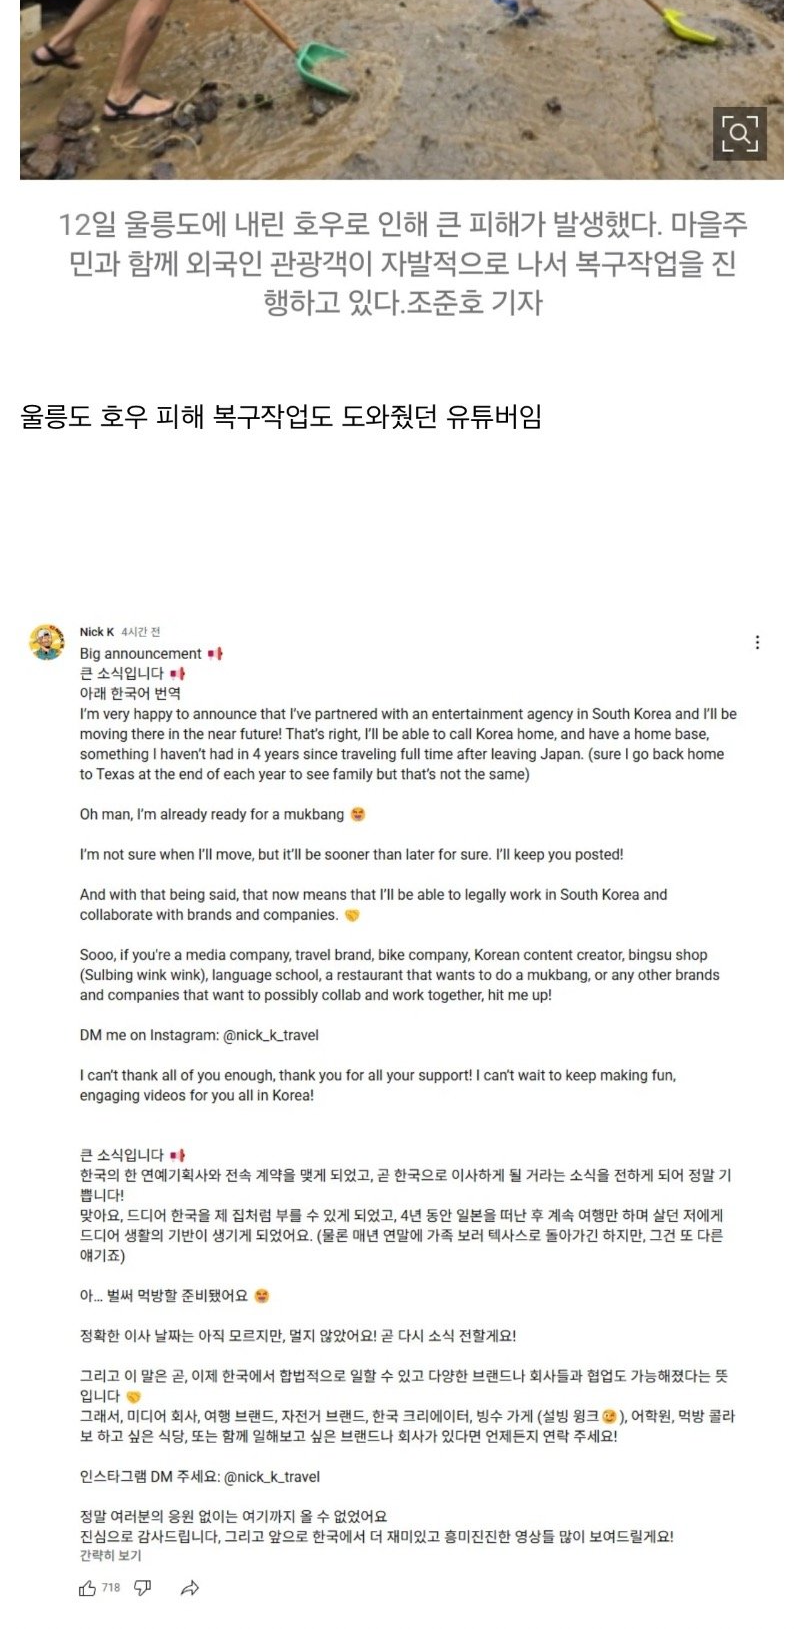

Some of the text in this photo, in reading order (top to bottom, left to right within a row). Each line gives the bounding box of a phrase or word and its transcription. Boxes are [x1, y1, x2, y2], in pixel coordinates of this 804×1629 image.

[80, 627, 160, 637] Nick K 4시간 전
[81, 648, 202, 662] Big announcement
[80, 667, 164, 680] 큰 소식입니다
[80, 687, 180, 700] 아래 한국어 번역
[80, 909, 338, 923] collaborate with brands and companies.
[81, 1029, 318, 1044] DM me on Instagram: @nick_k_travel
[80, 1089, 313, 1104] engaging videos for you all in Korea!
[80, 1148, 164, 1162] 큰 소식입니다
[80, 1189, 123, 1202] 쁩니다!
[80, 1470, 320, 1486] 인스타그램 DM 주세요: @nick_k_travel
[80, 1549, 141, 1562] 간략히 보기
[102, 1583, 120, 1592] 718
